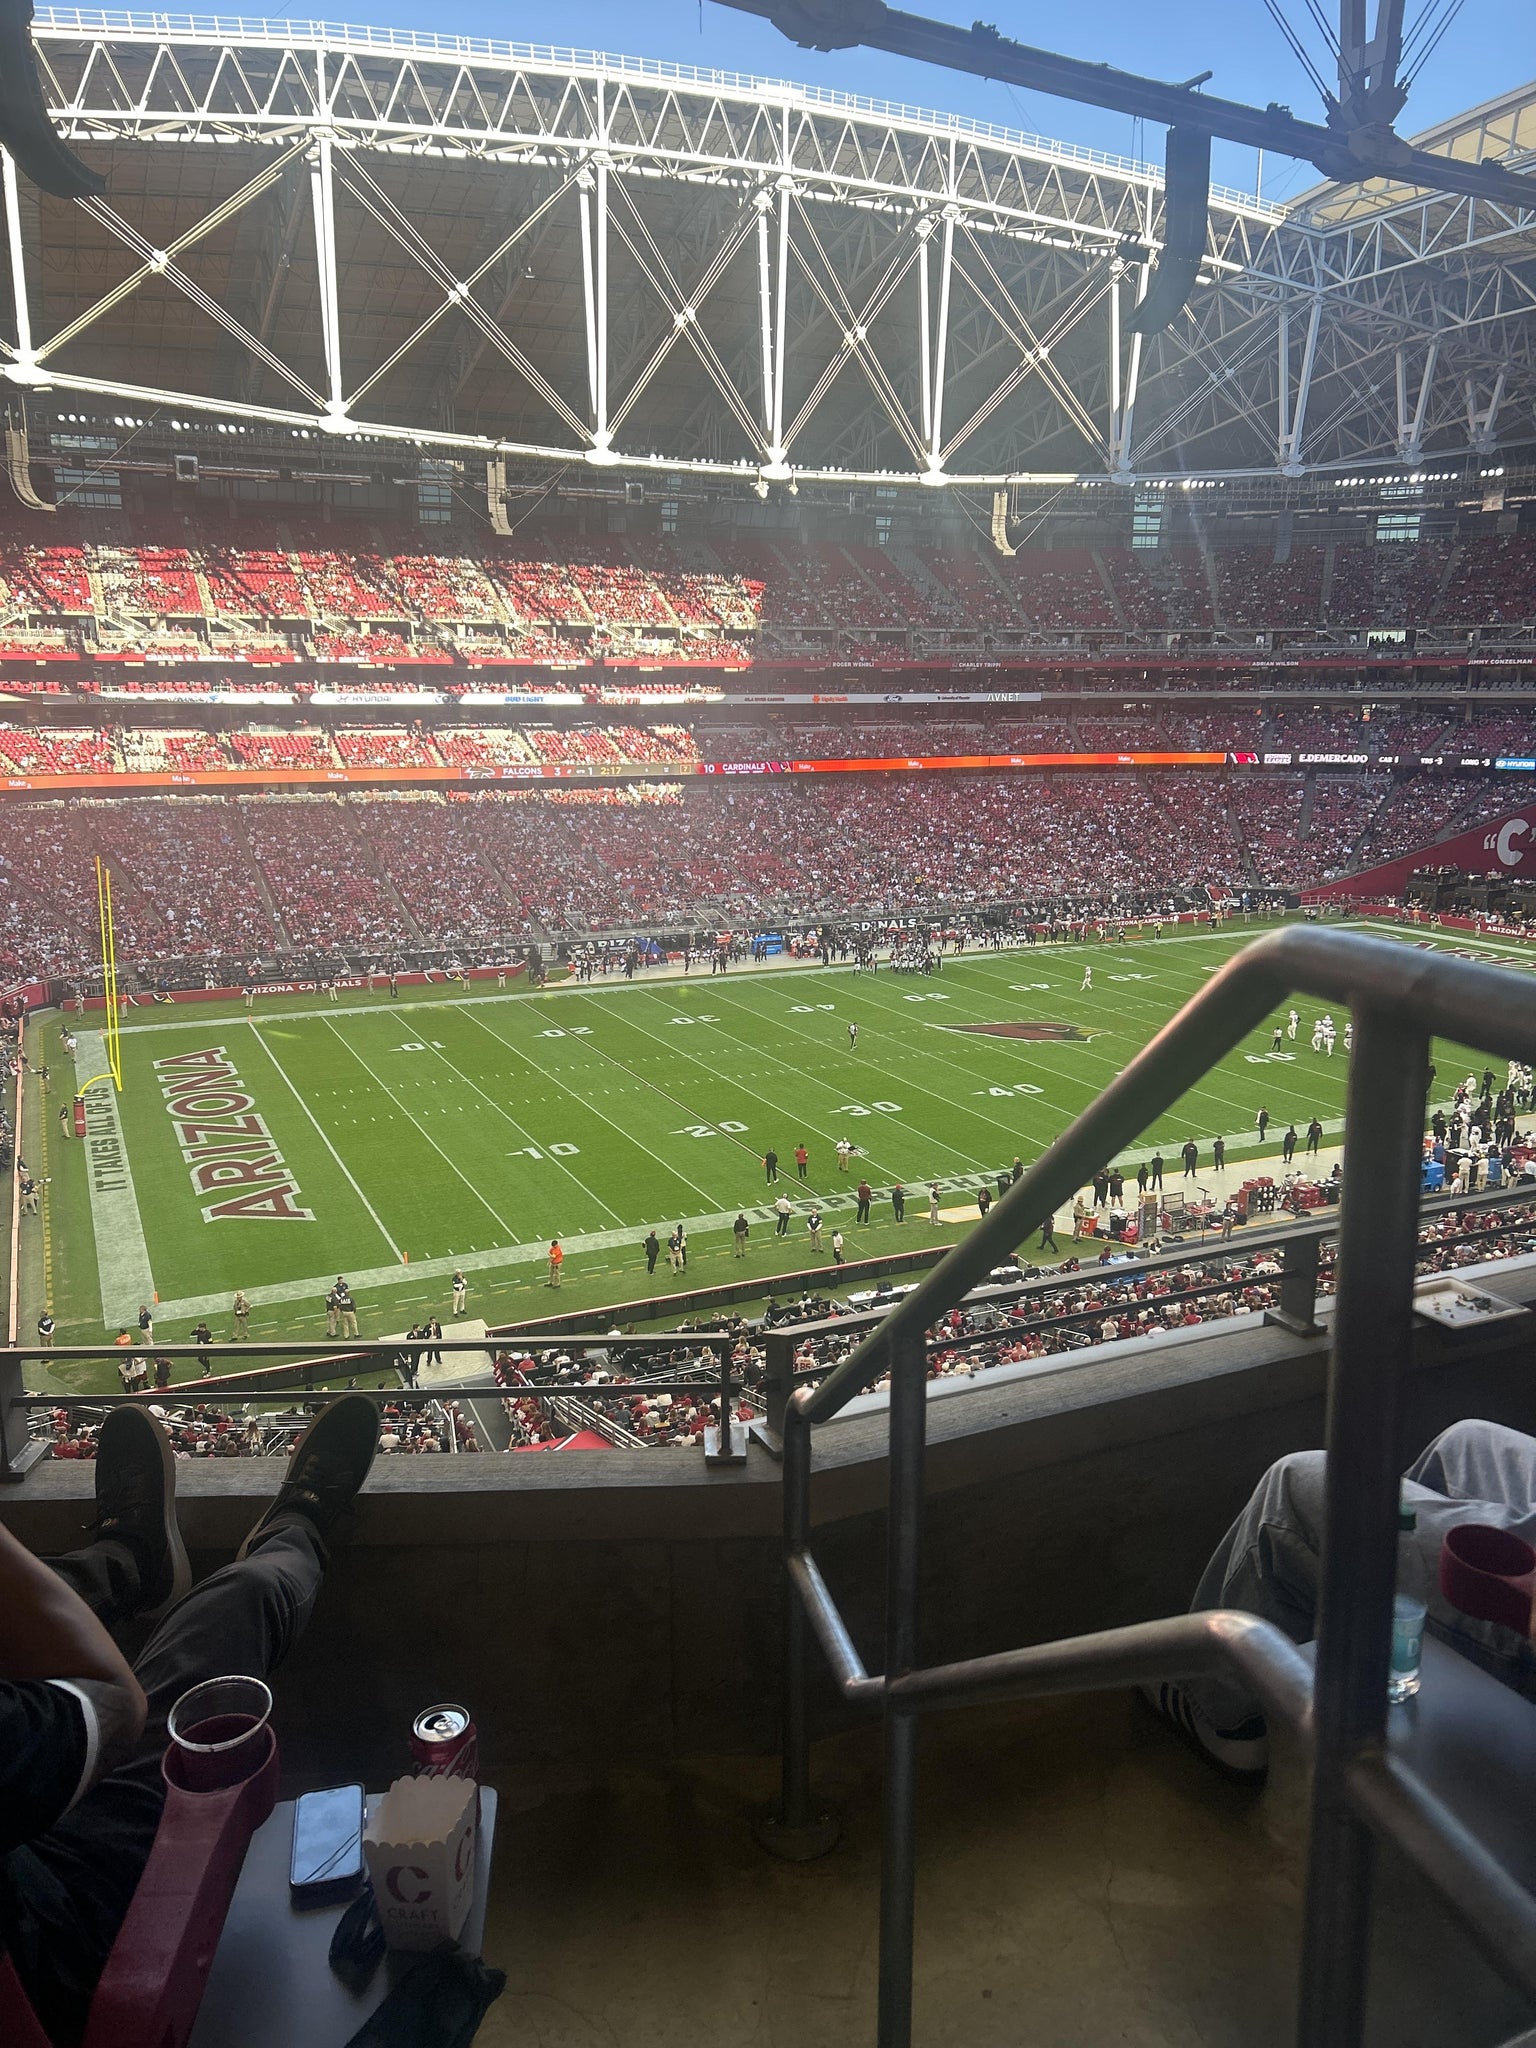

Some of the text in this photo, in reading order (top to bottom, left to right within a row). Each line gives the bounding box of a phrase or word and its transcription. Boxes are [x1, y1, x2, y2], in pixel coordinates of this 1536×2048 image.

[987, 693, 1020, 702] AVNET
[1299, 754, 1368, 763] E.DEMERCADO
[554, 768, 561, 776] 3
[600, 766, 622, 775] 2:17
[704, 764, 714, 773] 10
[1008, 983, 1051, 992] 40
[902, 992, 950, 1002] 50
[790, 1004, 836, 1014] 40
[671, 1014, 721, 1026] 30
[542, 1026, 594, 1038] 20
[400, 1040, 446, 1052] 10
[1244, 1051, 1297, 1064] 40
[988, 1083, 1045, 1098] 40
[839, 1100, 904, 1117] 30
[153, 1046, 316, 1224] ARIZONA
[683, 1120, 750, 1138] 20
[84, 1088, 128, 1192] IT TAKES ALL OF US
[522, 1142, 580, 1160] 10
[406, 1427, 413, 1438] 5
